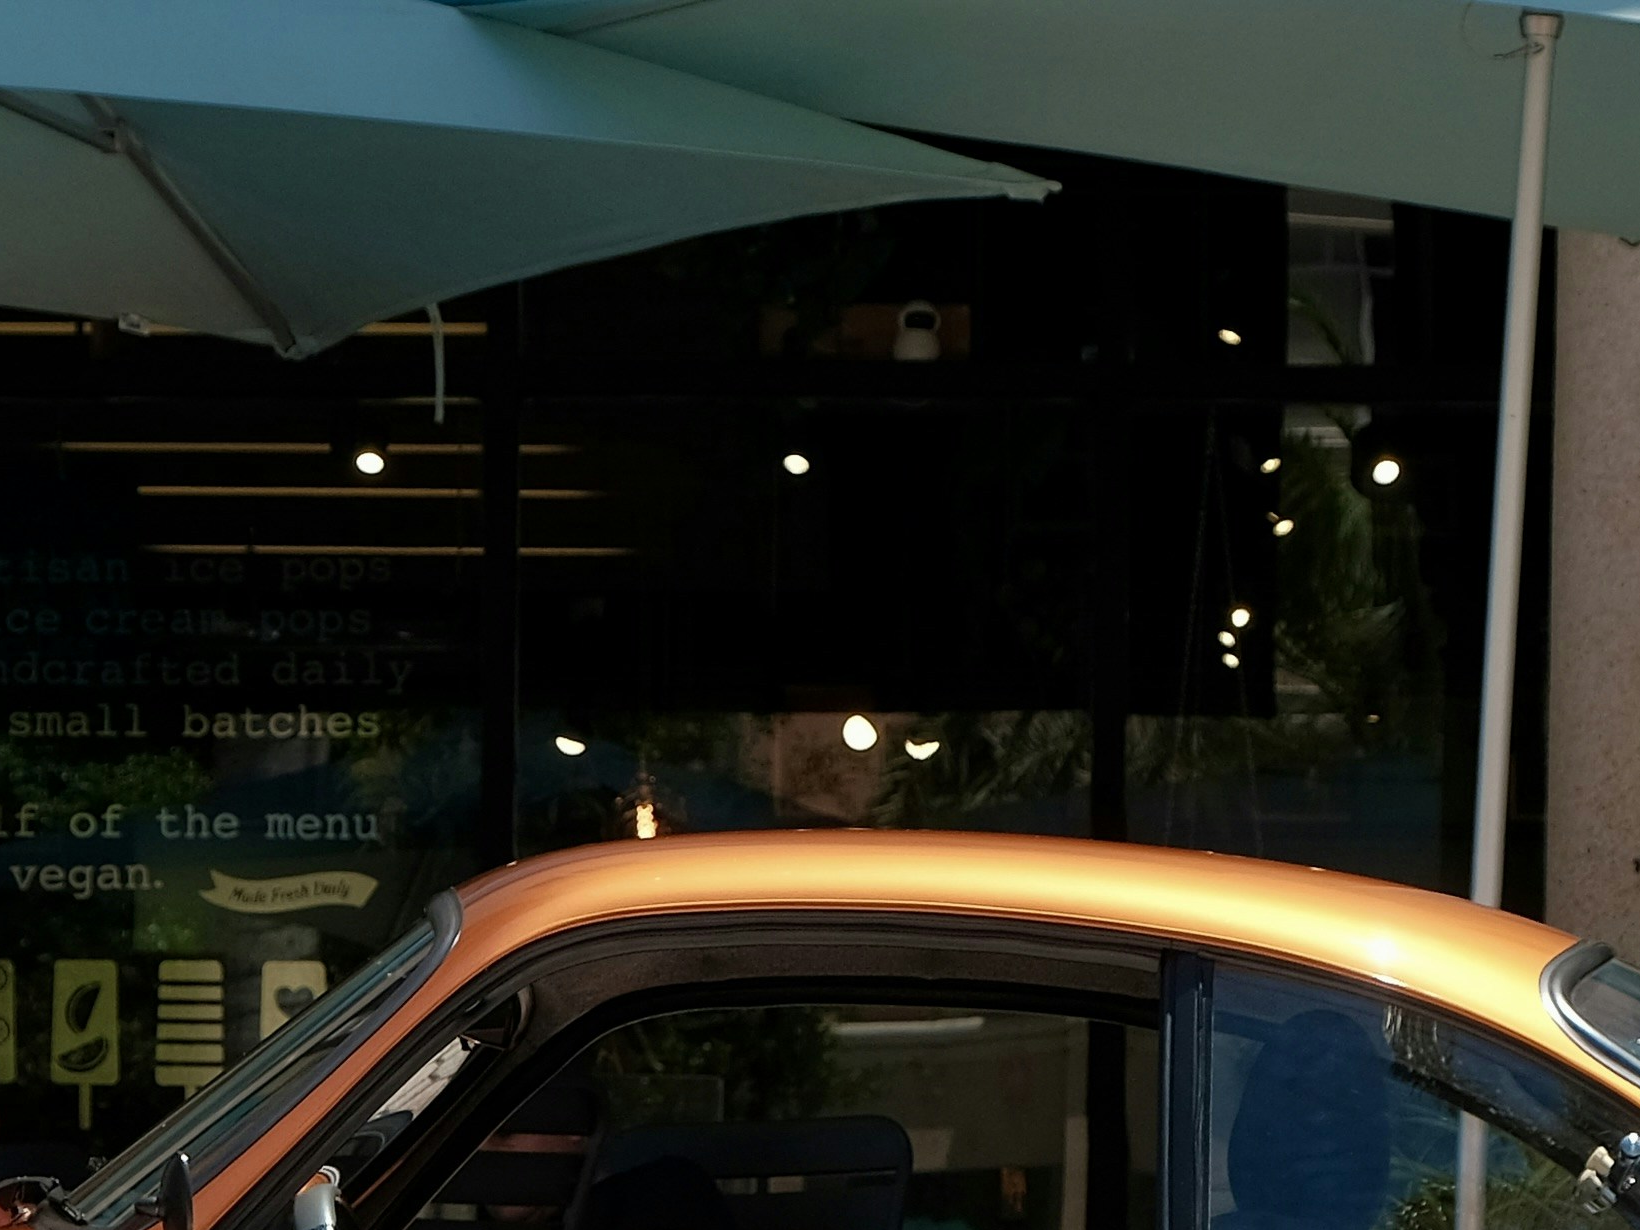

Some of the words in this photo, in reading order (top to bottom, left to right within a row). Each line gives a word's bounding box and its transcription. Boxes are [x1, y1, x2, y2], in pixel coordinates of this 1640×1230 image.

[164, 556, 245, 586] ice
[282, 558, 392, 593] pops
[85, 606, 230, 636] cream
[259, 606, 372, 643] pops
[271, 655, 414, 695] daily
[8, 703, 148, 738] small
[182, 705, 382, 739] batches
[68, 805, 126, 840] of
[155, 806, 240, 840] the
[264, 812, 382, 841] menu
[9, 866, 166, 901] vegan.
[270, 884, 310, 903] Fresh
